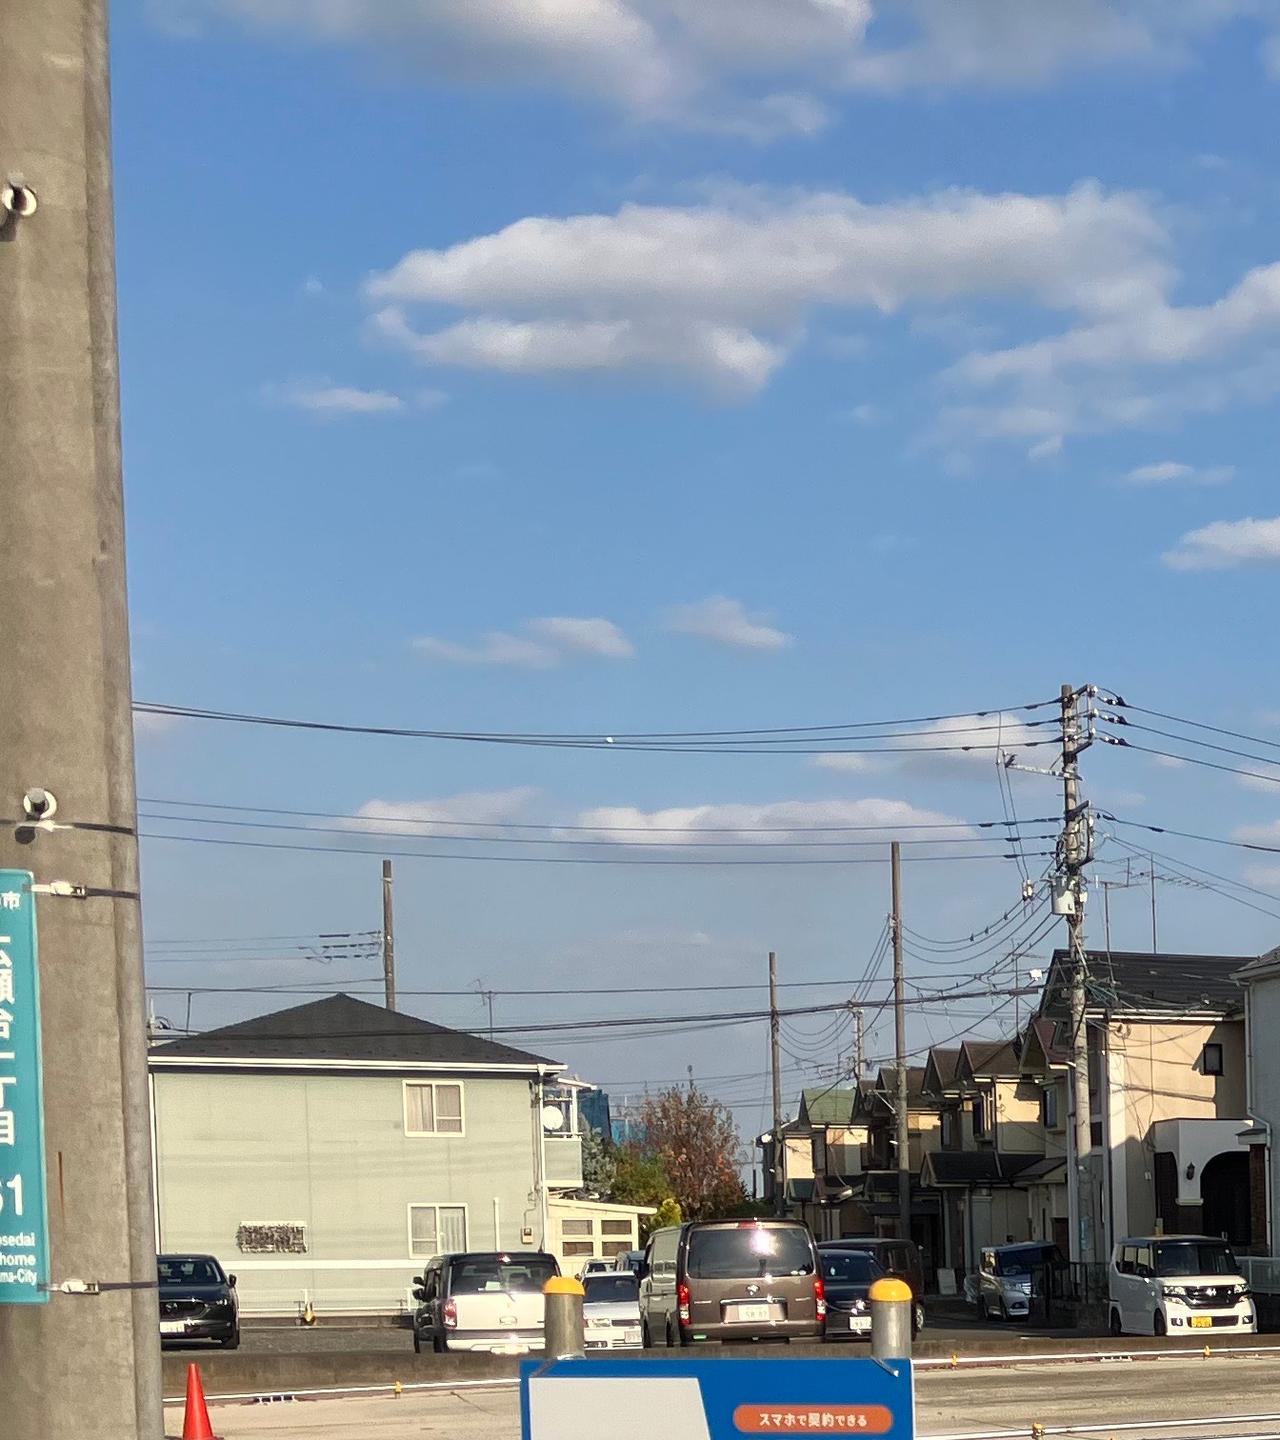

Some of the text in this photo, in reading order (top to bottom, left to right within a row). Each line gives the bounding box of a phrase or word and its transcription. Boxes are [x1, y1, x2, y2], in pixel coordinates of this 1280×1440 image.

[0, 890, 21, 910] 市
[0, 1173, 23, 1216] 1
[0, 1232, 36, 1247] sedai
[759, 1412, 868, 1427] スマホで契約できる
